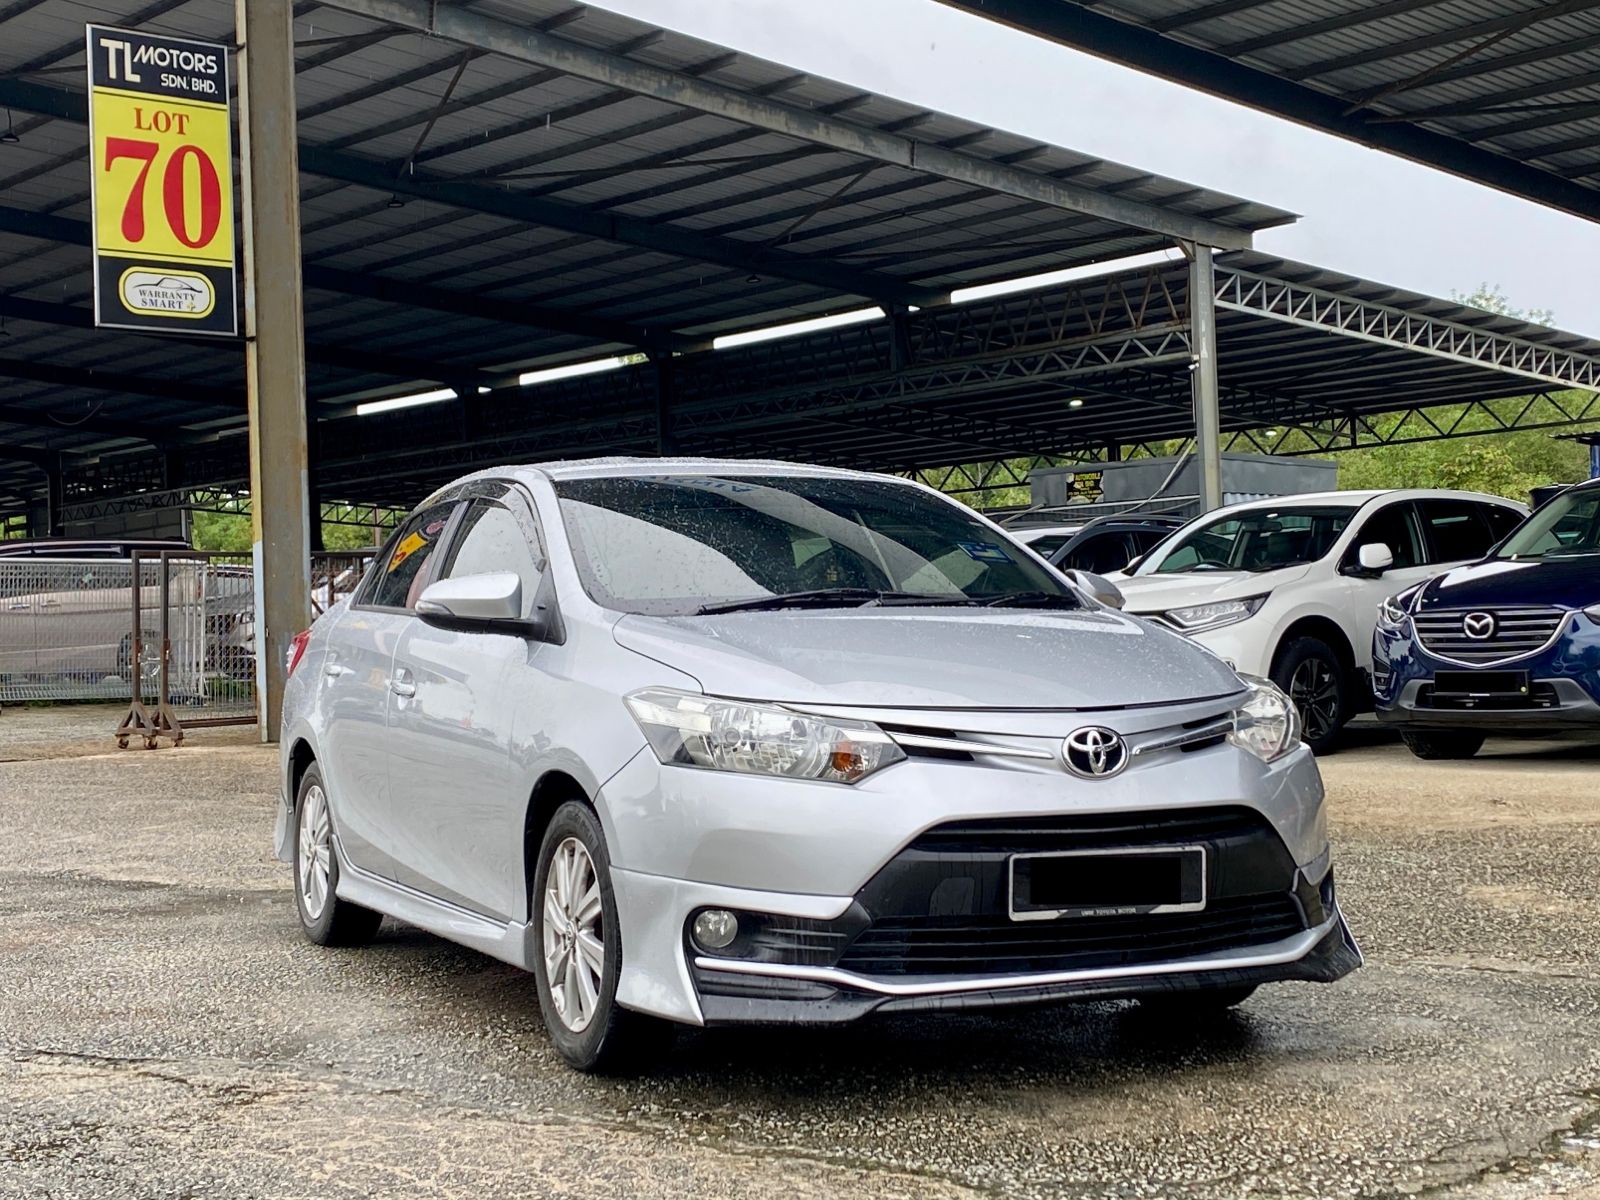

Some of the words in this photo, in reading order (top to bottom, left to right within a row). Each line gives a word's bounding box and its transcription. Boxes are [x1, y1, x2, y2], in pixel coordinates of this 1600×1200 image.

[100, 38, 141, 83] TL
[133, 45, 217, 74] MOTORS
[160, 73, 189, 90] SDN.
[191, 78, 218, 94] BHD.
[134, 107, 190, 135] LOT
[105, 136, 222, 249] 70
[139, 289, 196, 301] WARRANTY
[141, 298, 184, 310] SMART
